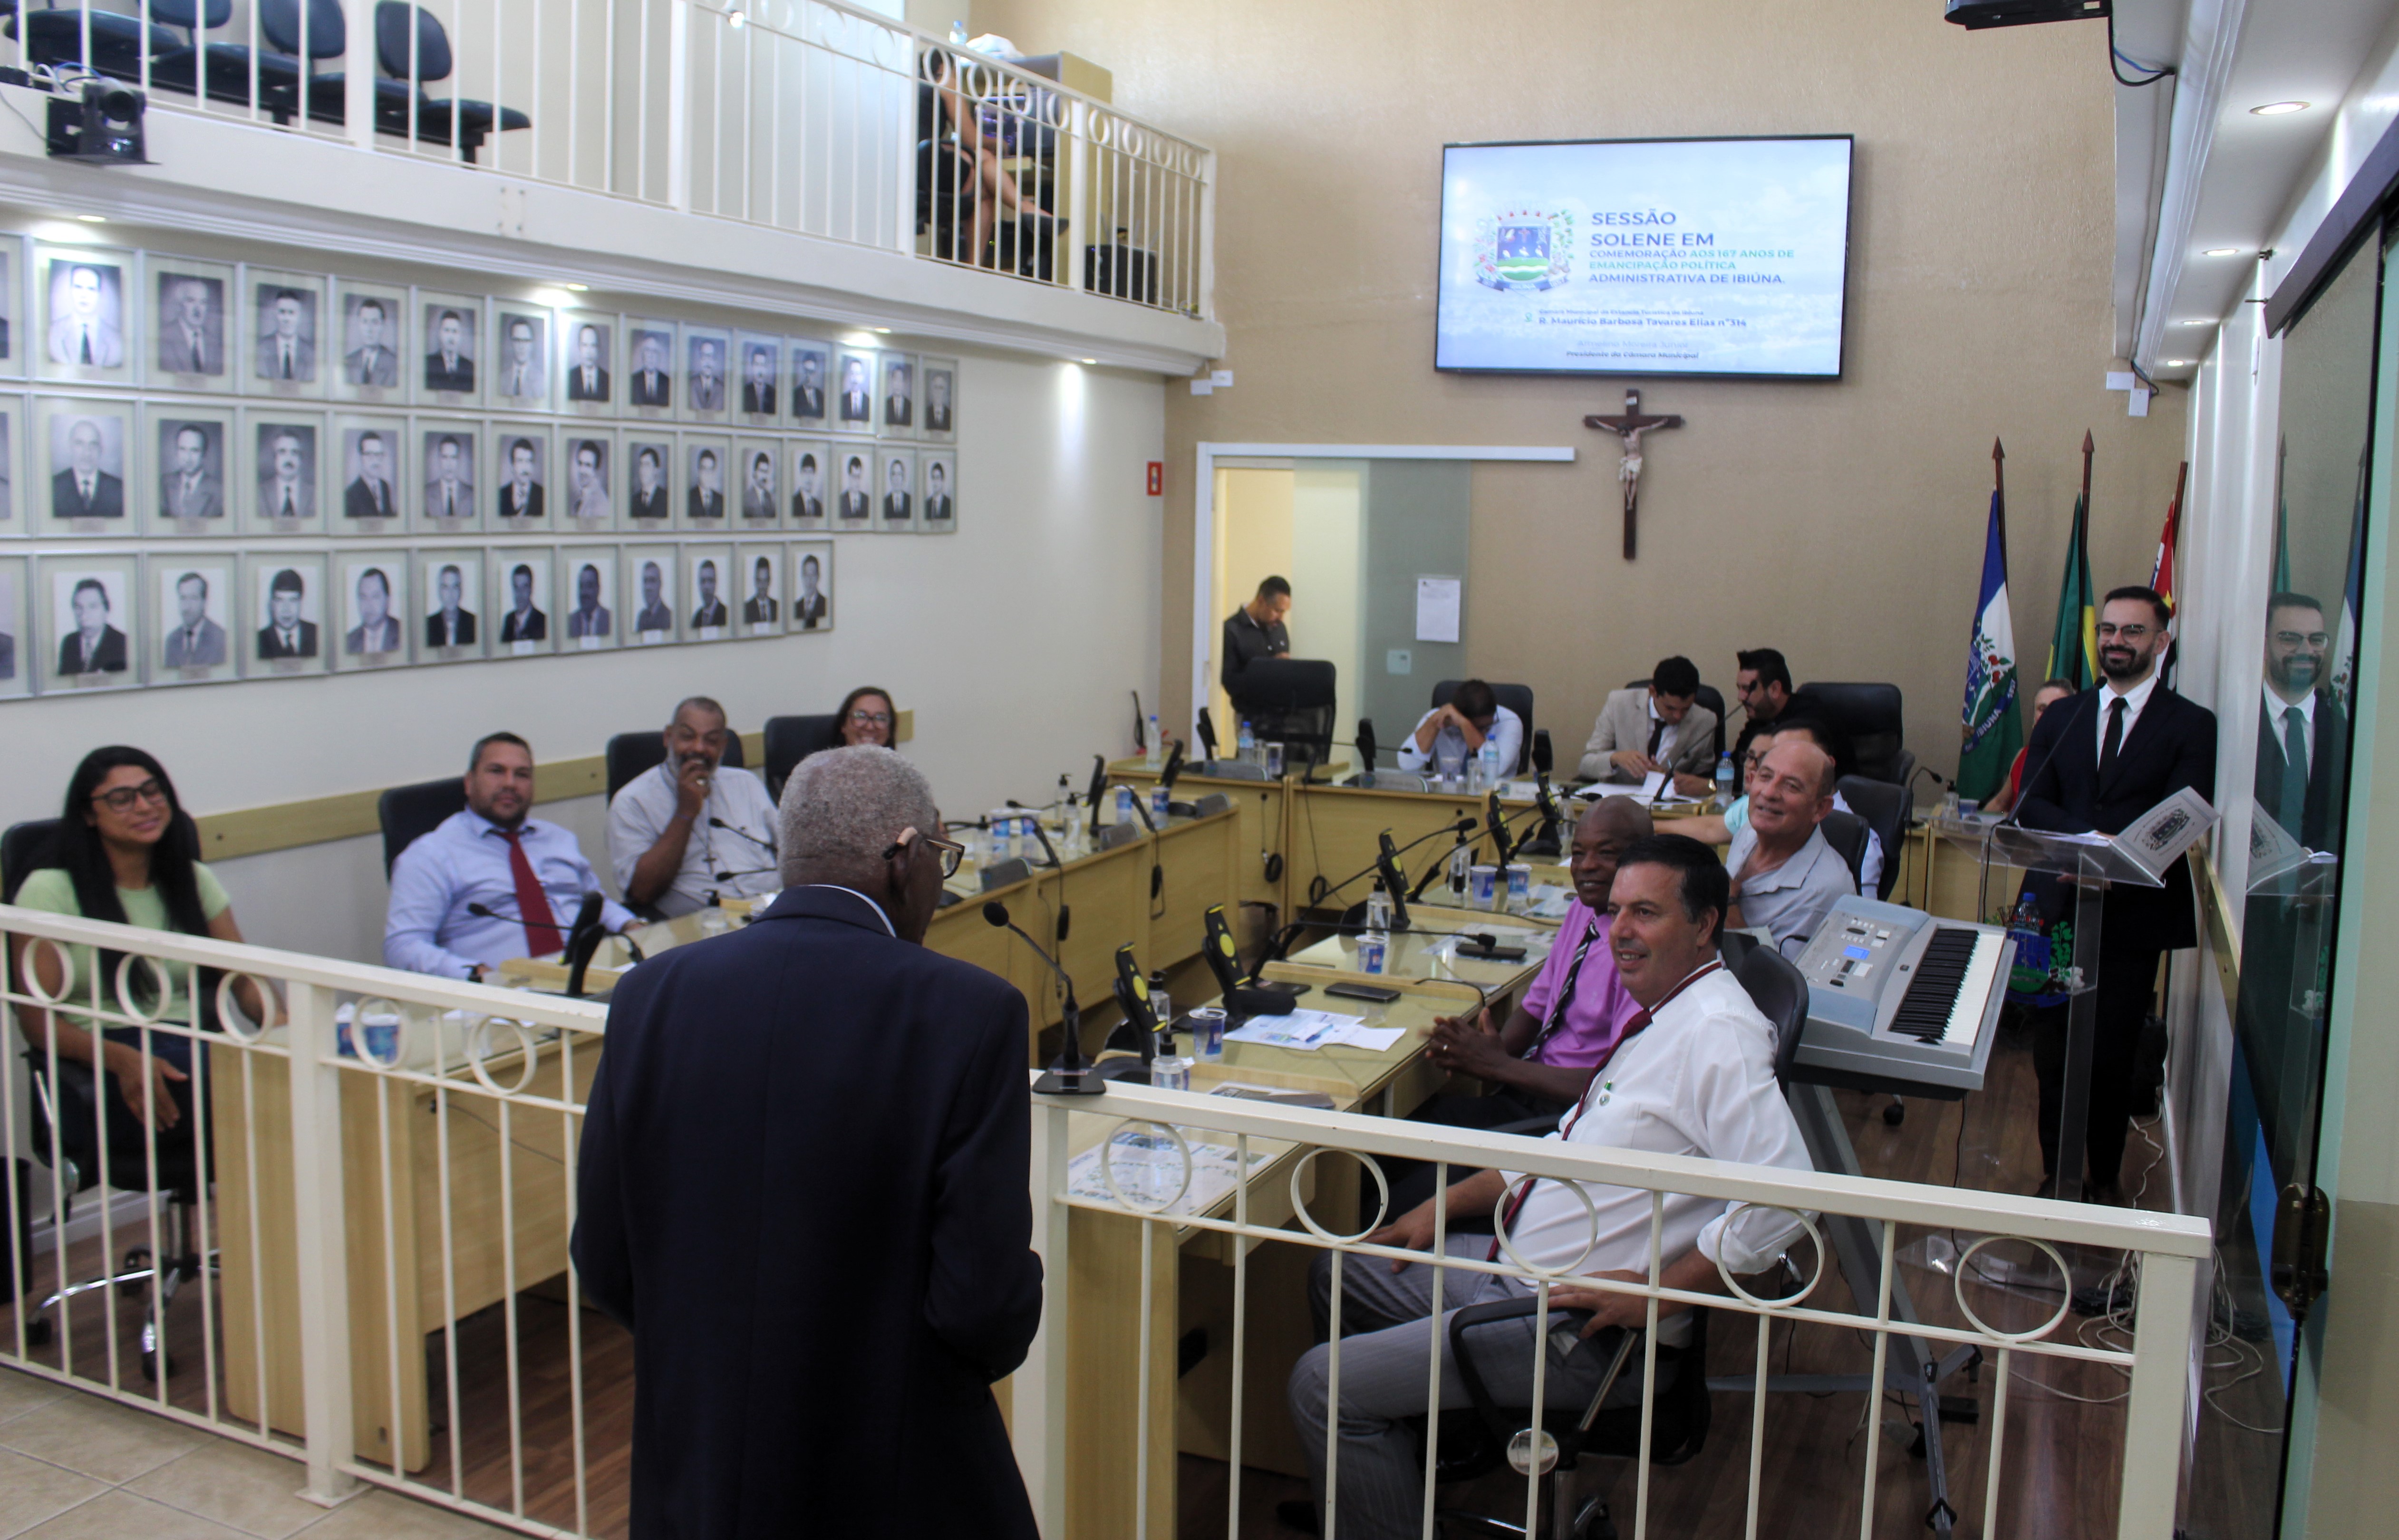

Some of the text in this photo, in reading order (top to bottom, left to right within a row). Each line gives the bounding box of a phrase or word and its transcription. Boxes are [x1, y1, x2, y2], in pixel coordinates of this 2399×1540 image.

[1591, 208, 1676, 226] SESSÃO
[1590, 233, 1714, 247] SOLENE EM
[1589, 247, 1795, 260] COMEMORAÇÃO AOS 167 ANOS DE
[1589, 259, 1736, 271] EMANCIPAÇÃO POLÍTICA
[1588, 273, 1707, 283] ADMINISTRATIVA
[1710, 274, 1729, 283] DE
[1689, 318, 1715, 326] Elias
